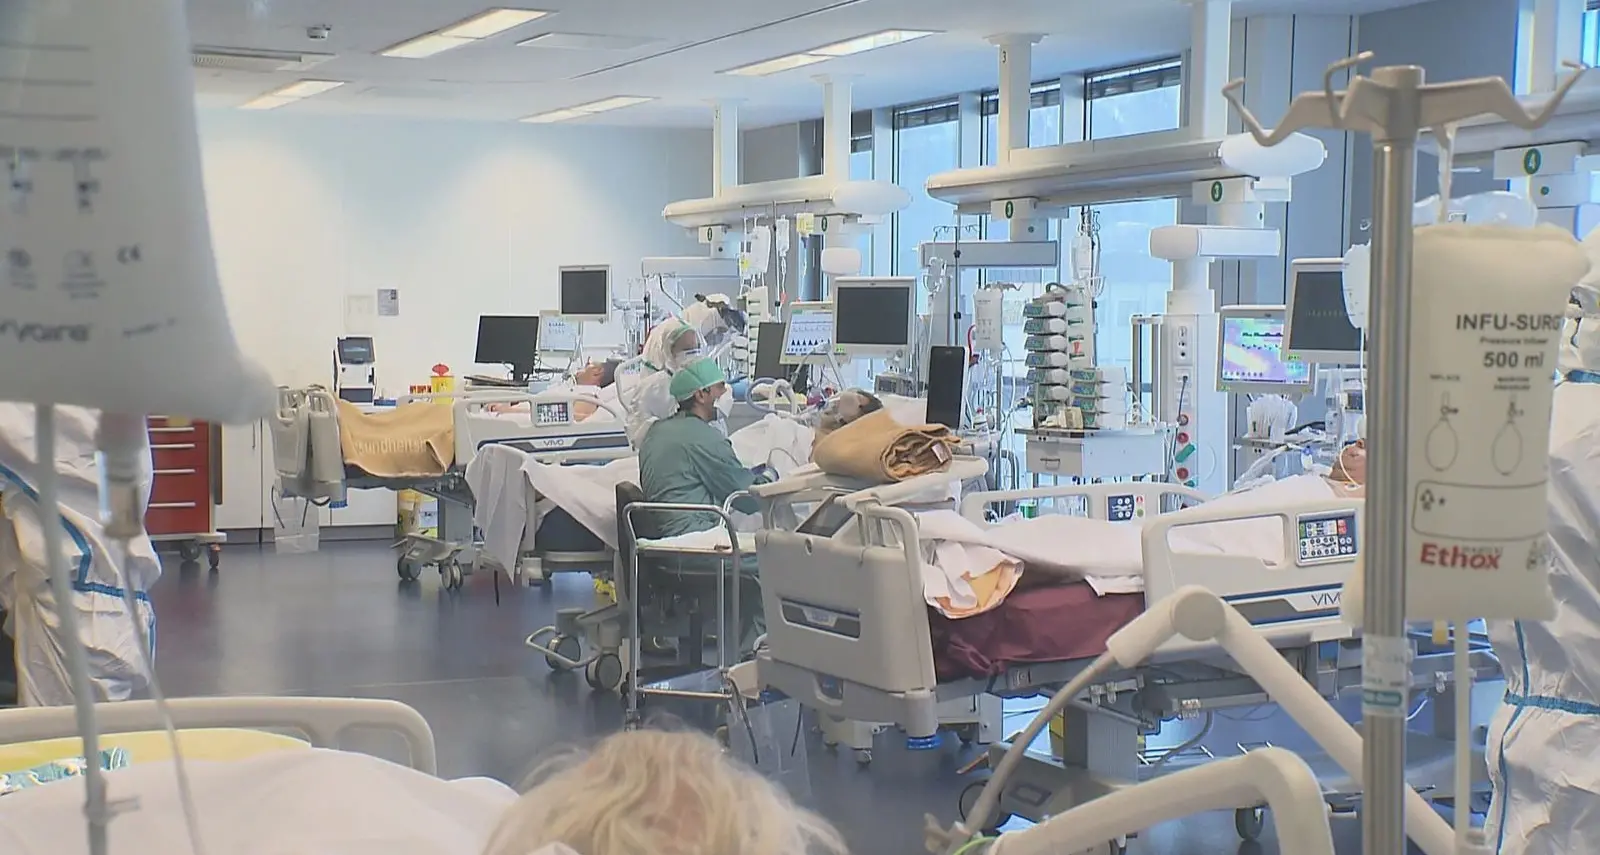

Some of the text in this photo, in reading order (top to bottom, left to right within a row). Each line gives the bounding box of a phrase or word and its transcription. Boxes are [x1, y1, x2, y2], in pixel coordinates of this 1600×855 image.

[1483, 352, 1545, 368] 500 ml
[543, 438, 565, 447] VIVO
[1420, 542, 1501, 570] Ethox
[1311, 591, 1341, 606] VIV
